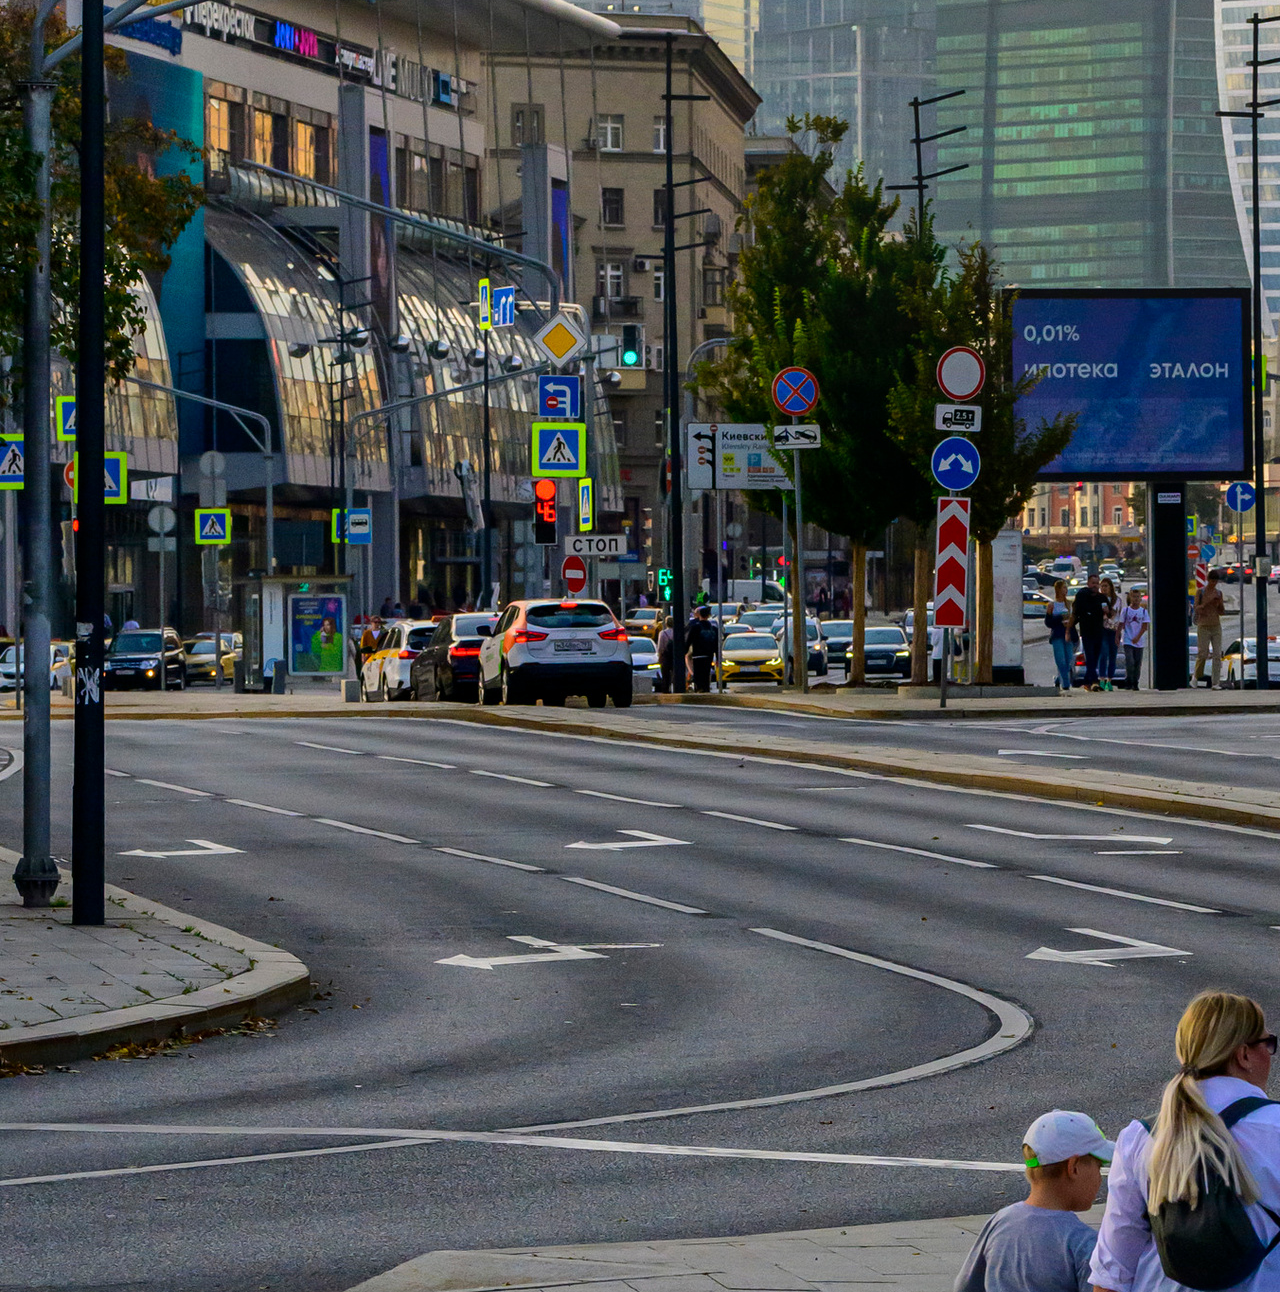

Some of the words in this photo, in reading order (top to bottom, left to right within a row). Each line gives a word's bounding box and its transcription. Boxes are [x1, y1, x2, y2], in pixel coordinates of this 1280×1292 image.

[1023, 324, 1080, 345] 0,01%
[1024, 363, 1118, 378] ипотека
[722, 431, 767, 441] Киевски
[537, 501, 556, 522] 46
[573, 538, 618, 552] СТОП
